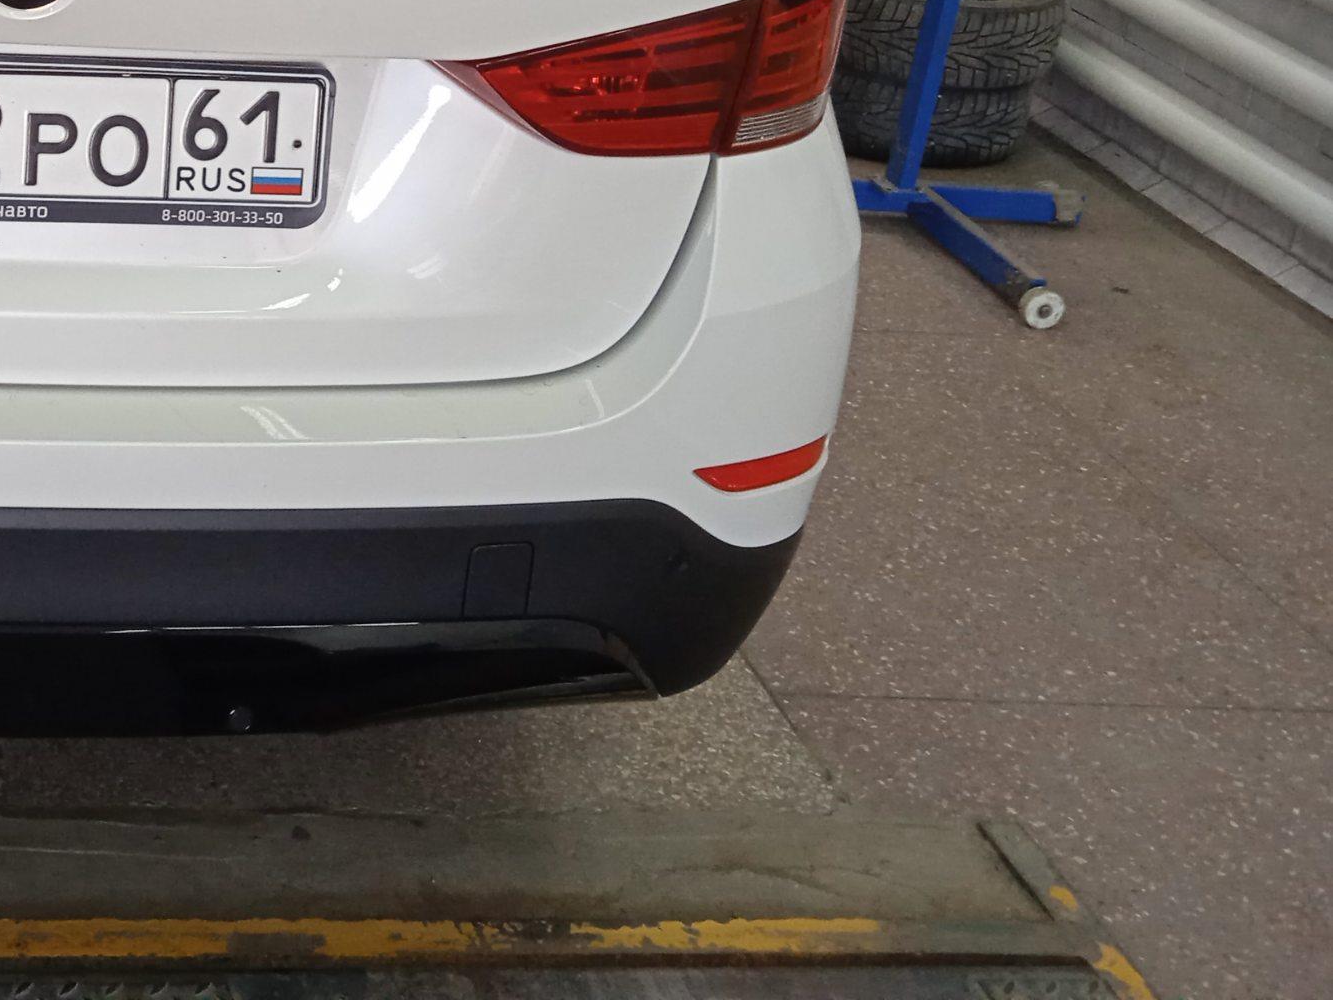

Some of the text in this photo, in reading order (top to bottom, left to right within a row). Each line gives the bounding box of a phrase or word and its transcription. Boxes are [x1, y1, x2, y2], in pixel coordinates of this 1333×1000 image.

[181, 88, 280, 164] 61
[175, 166, 246, 193] RUS
[161, 209, 284, 225] 8-800-301-33-50
